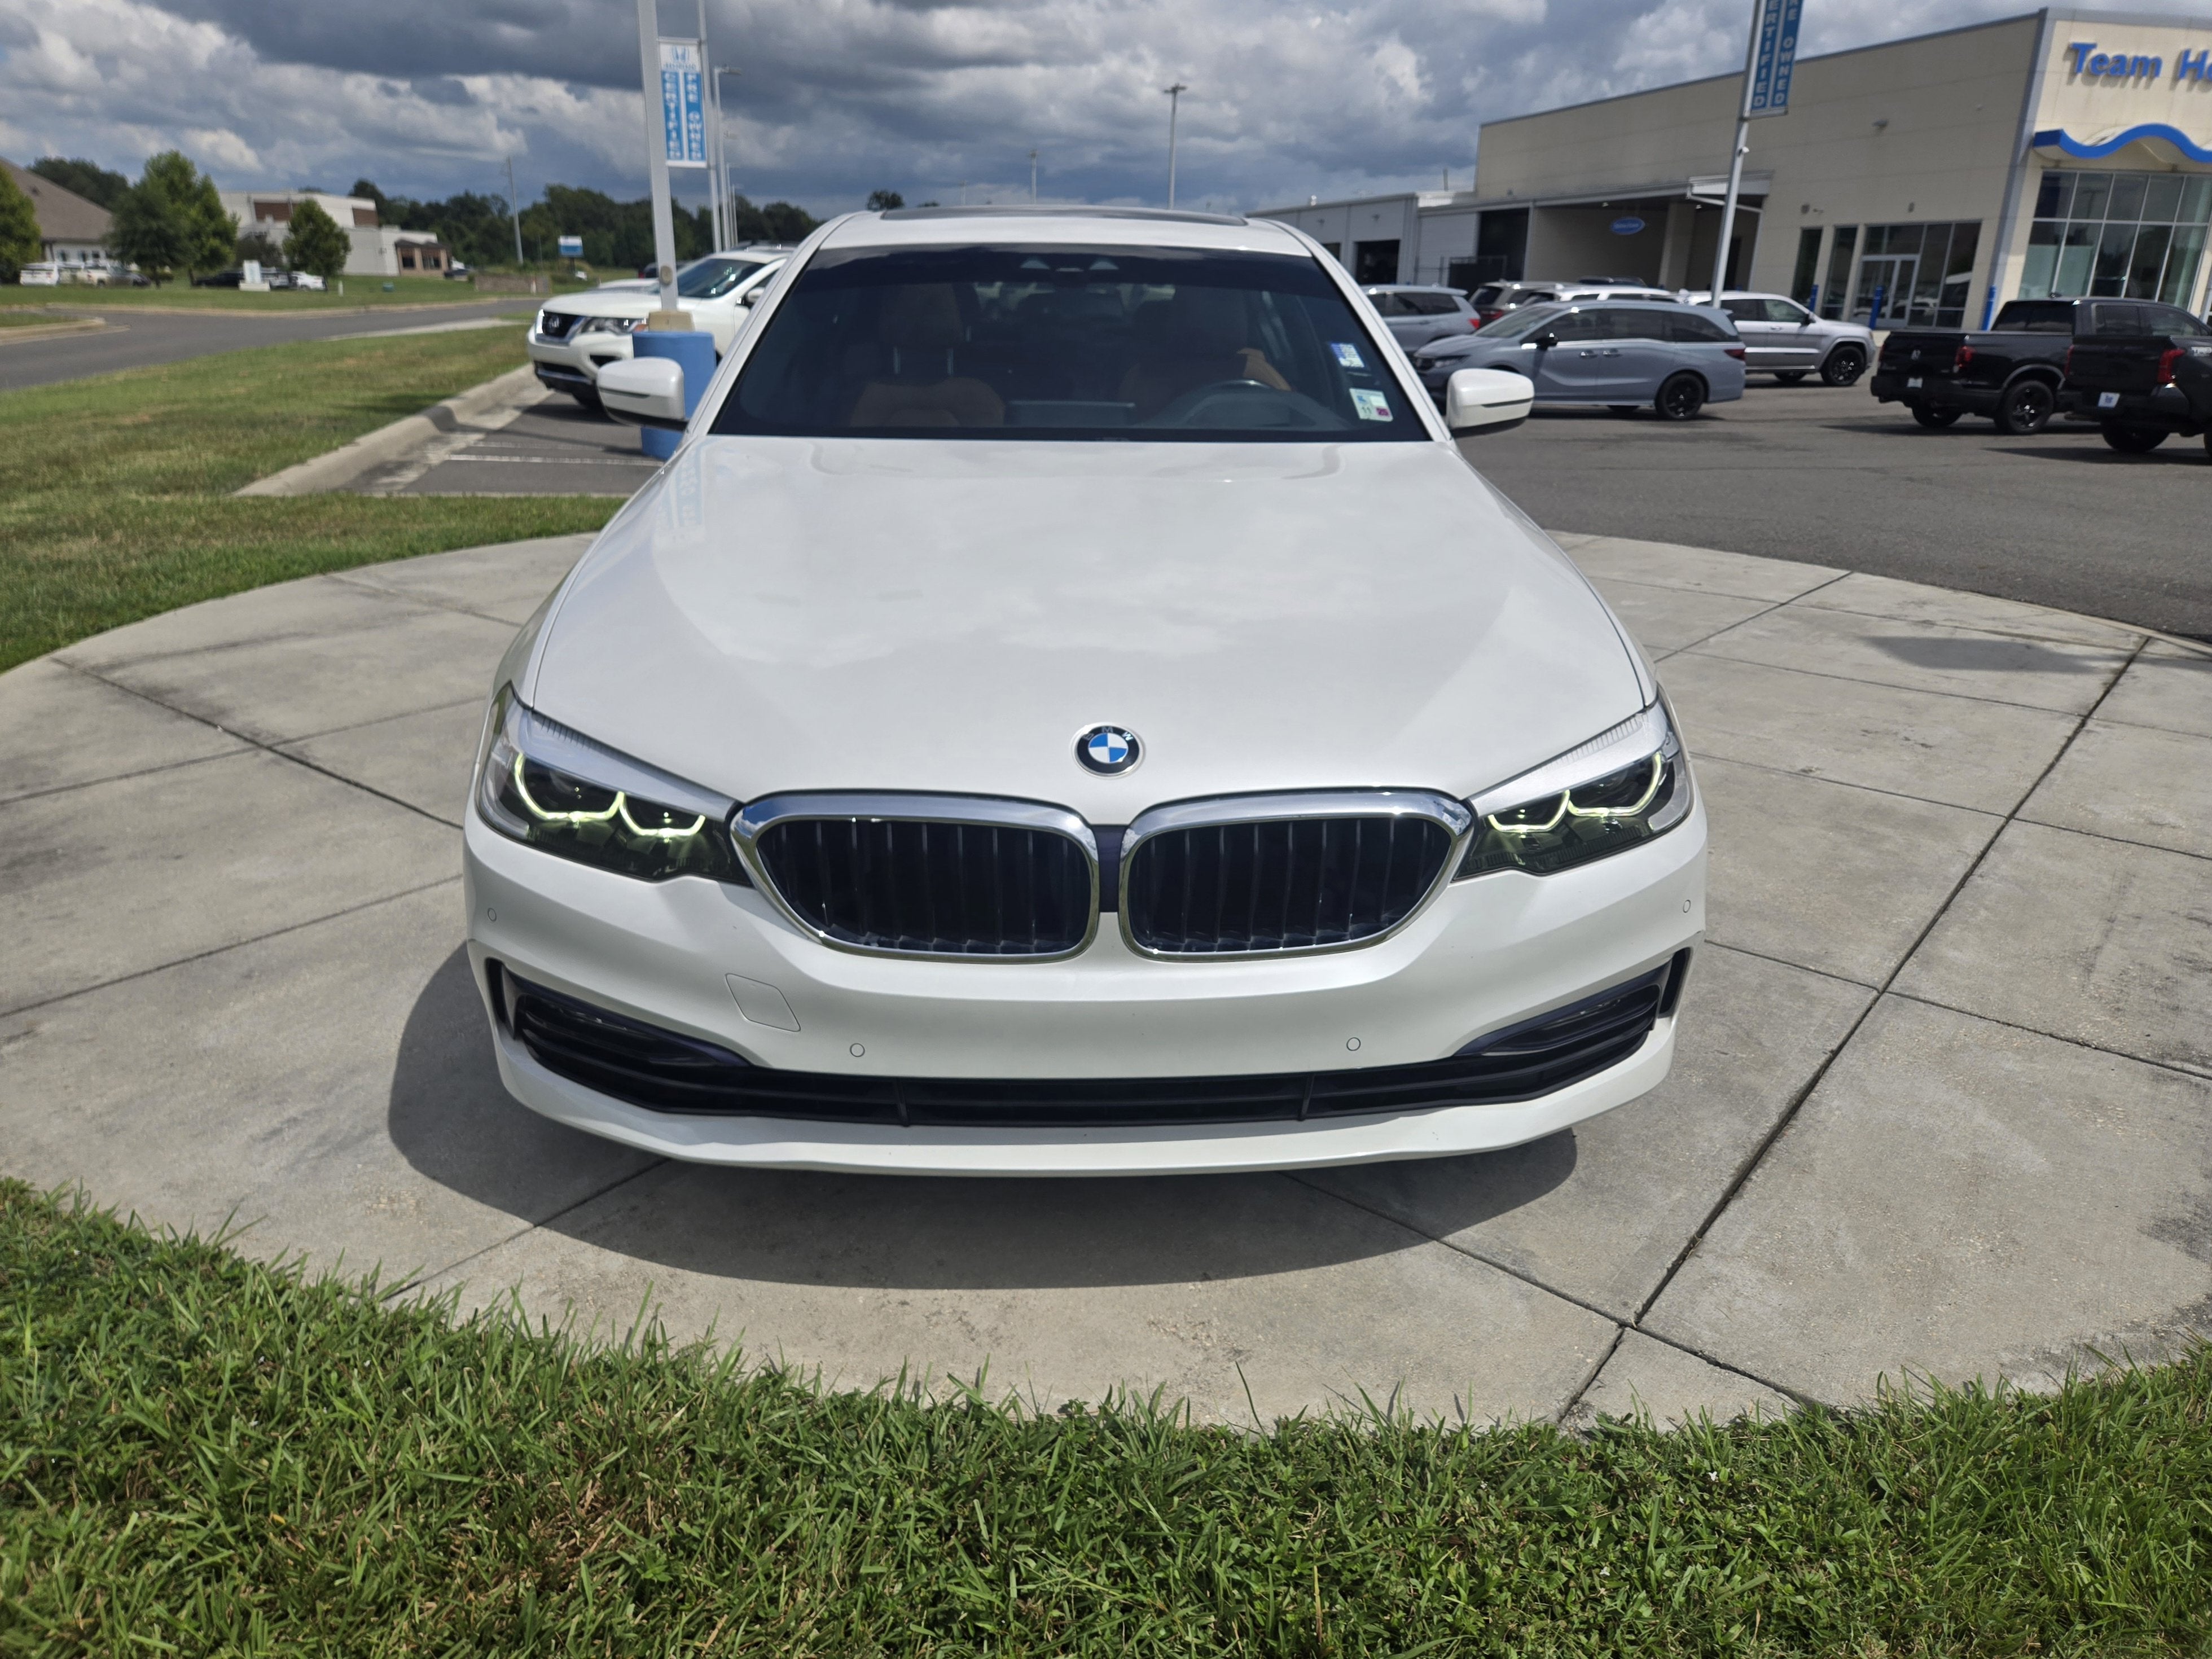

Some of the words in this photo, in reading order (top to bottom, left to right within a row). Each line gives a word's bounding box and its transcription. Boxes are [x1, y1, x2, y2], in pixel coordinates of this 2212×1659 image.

[1774, 36, 1795, 104] OWNED
[2069, 42, 2162, 78] Team
[1083, 726, 1134, 741] BMW
